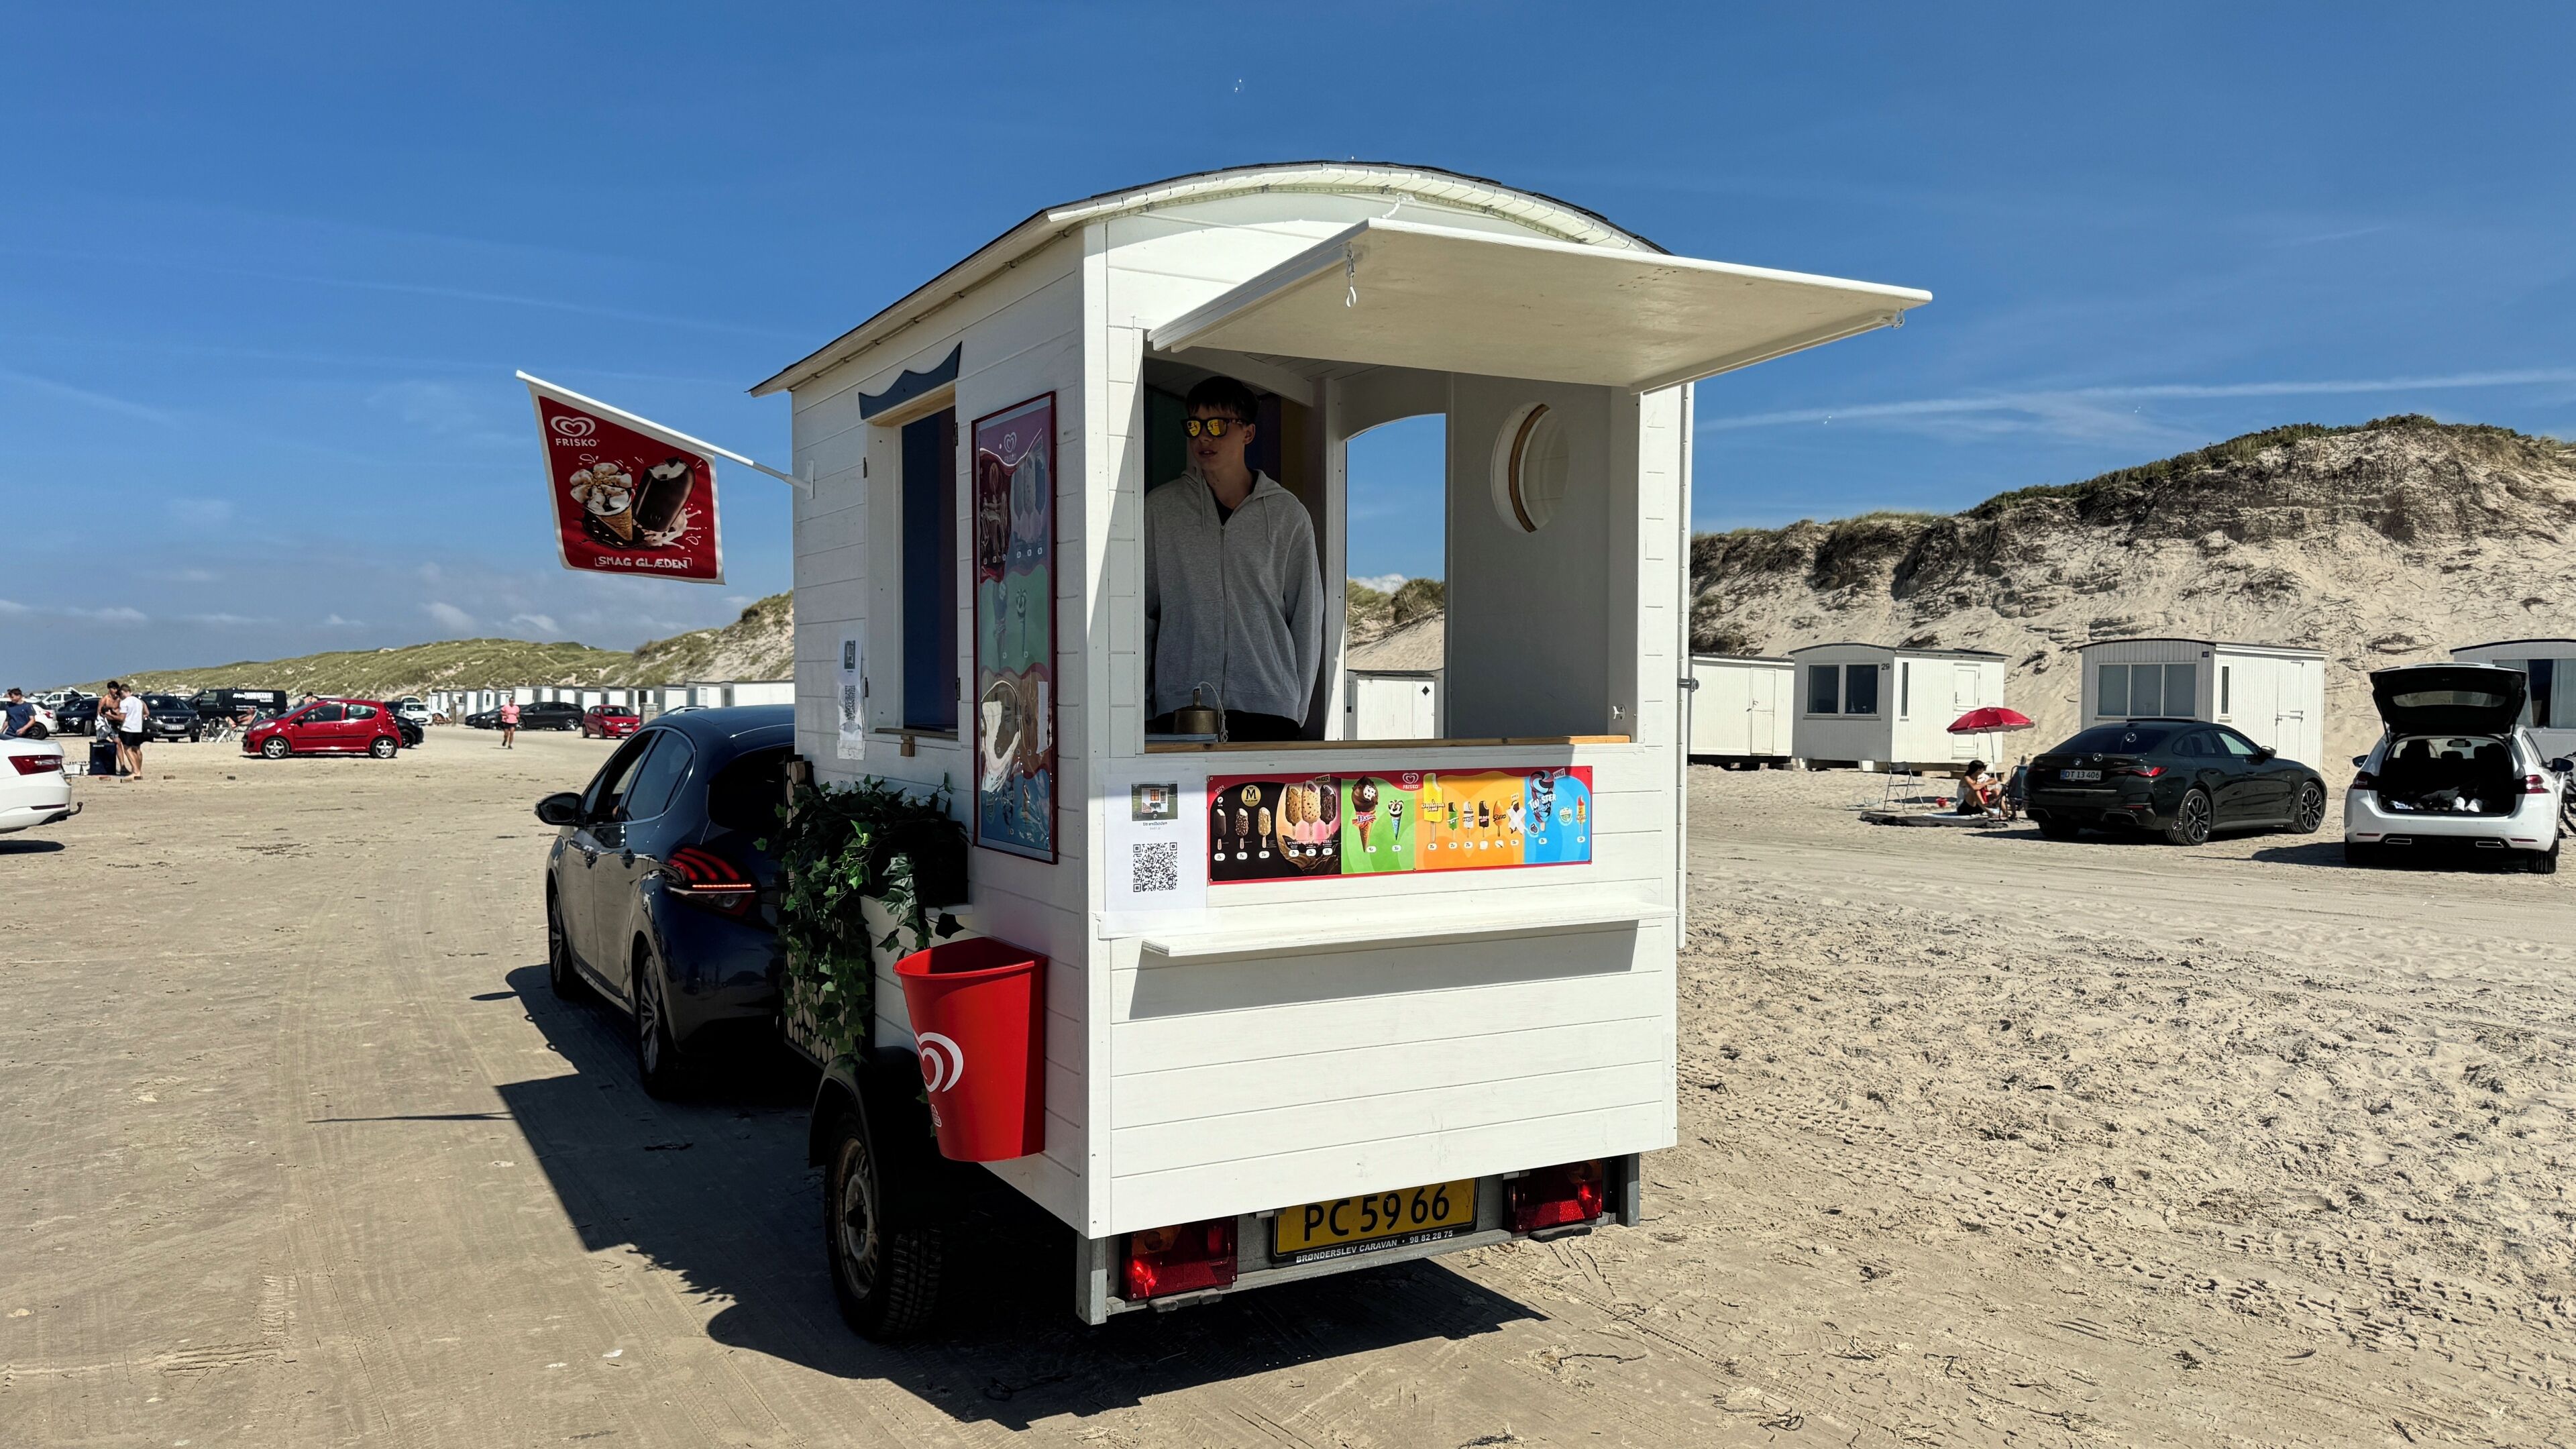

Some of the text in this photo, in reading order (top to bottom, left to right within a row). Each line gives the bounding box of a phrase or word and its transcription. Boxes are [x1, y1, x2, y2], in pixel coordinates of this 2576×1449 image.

[555, 438, 597, 447] FRISKO
[598, 556, 688, 569] SMAG GLÆDEN
[1246, 788, 1256, 799] M
[1304, 1185, 1450, 1241] PC 59 66
[1296, 1230, 1454, 1263] BRØNDERSLEV CARAVAN 98 82 28 75
